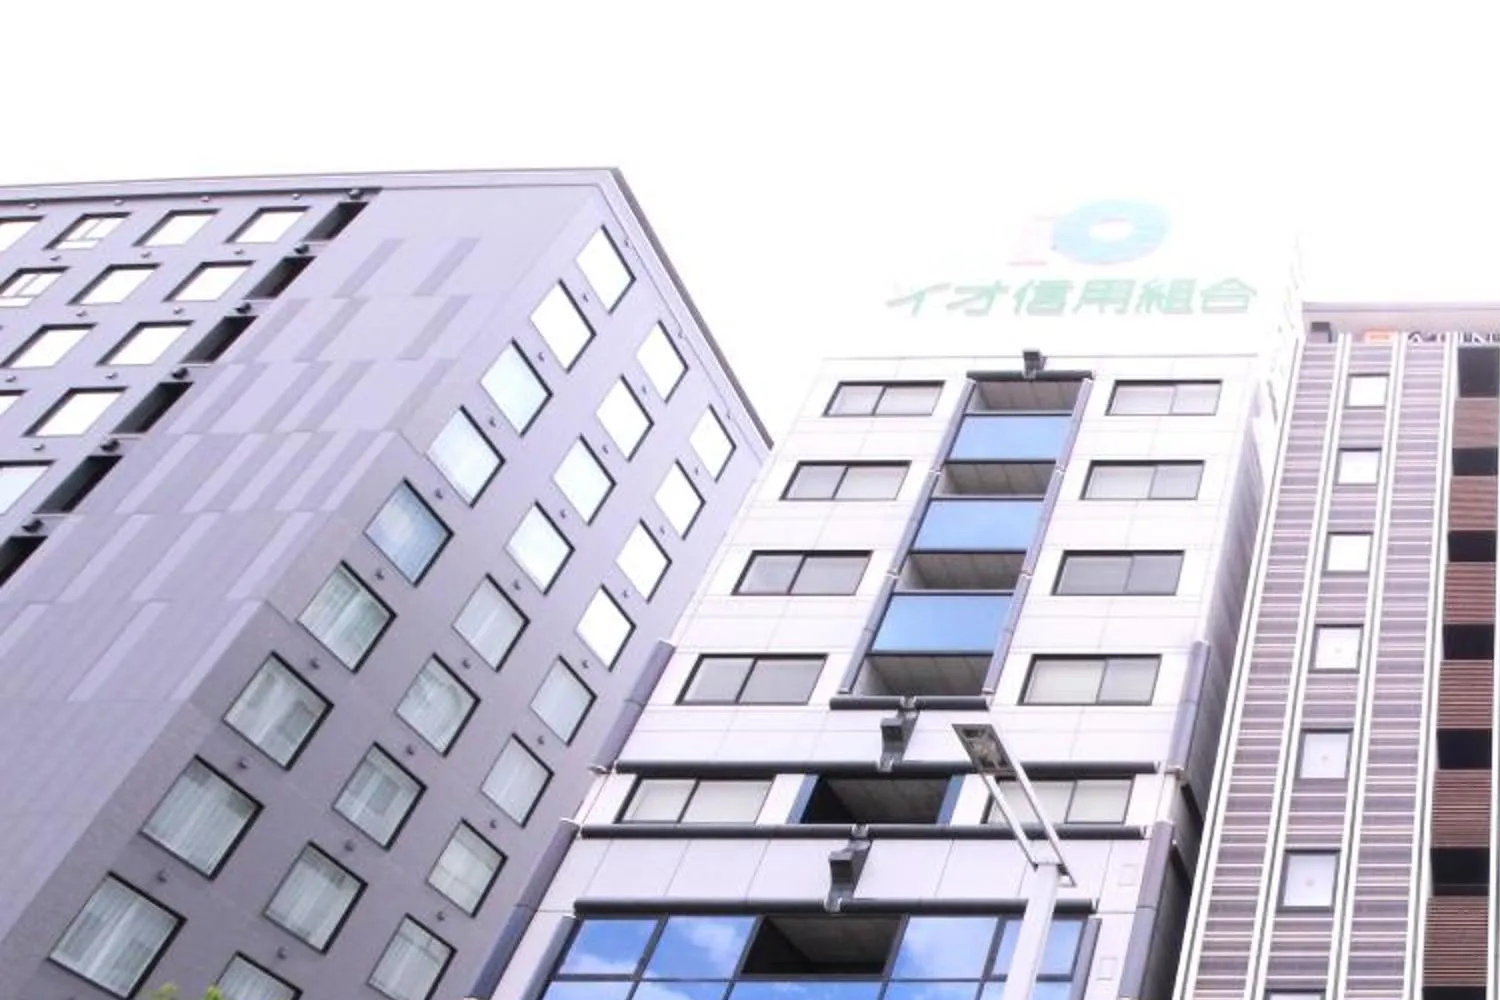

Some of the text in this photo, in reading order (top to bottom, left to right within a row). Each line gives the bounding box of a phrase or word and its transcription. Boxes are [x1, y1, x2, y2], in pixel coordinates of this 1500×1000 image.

[886, 276, 1258, 317] イオ信用組合
